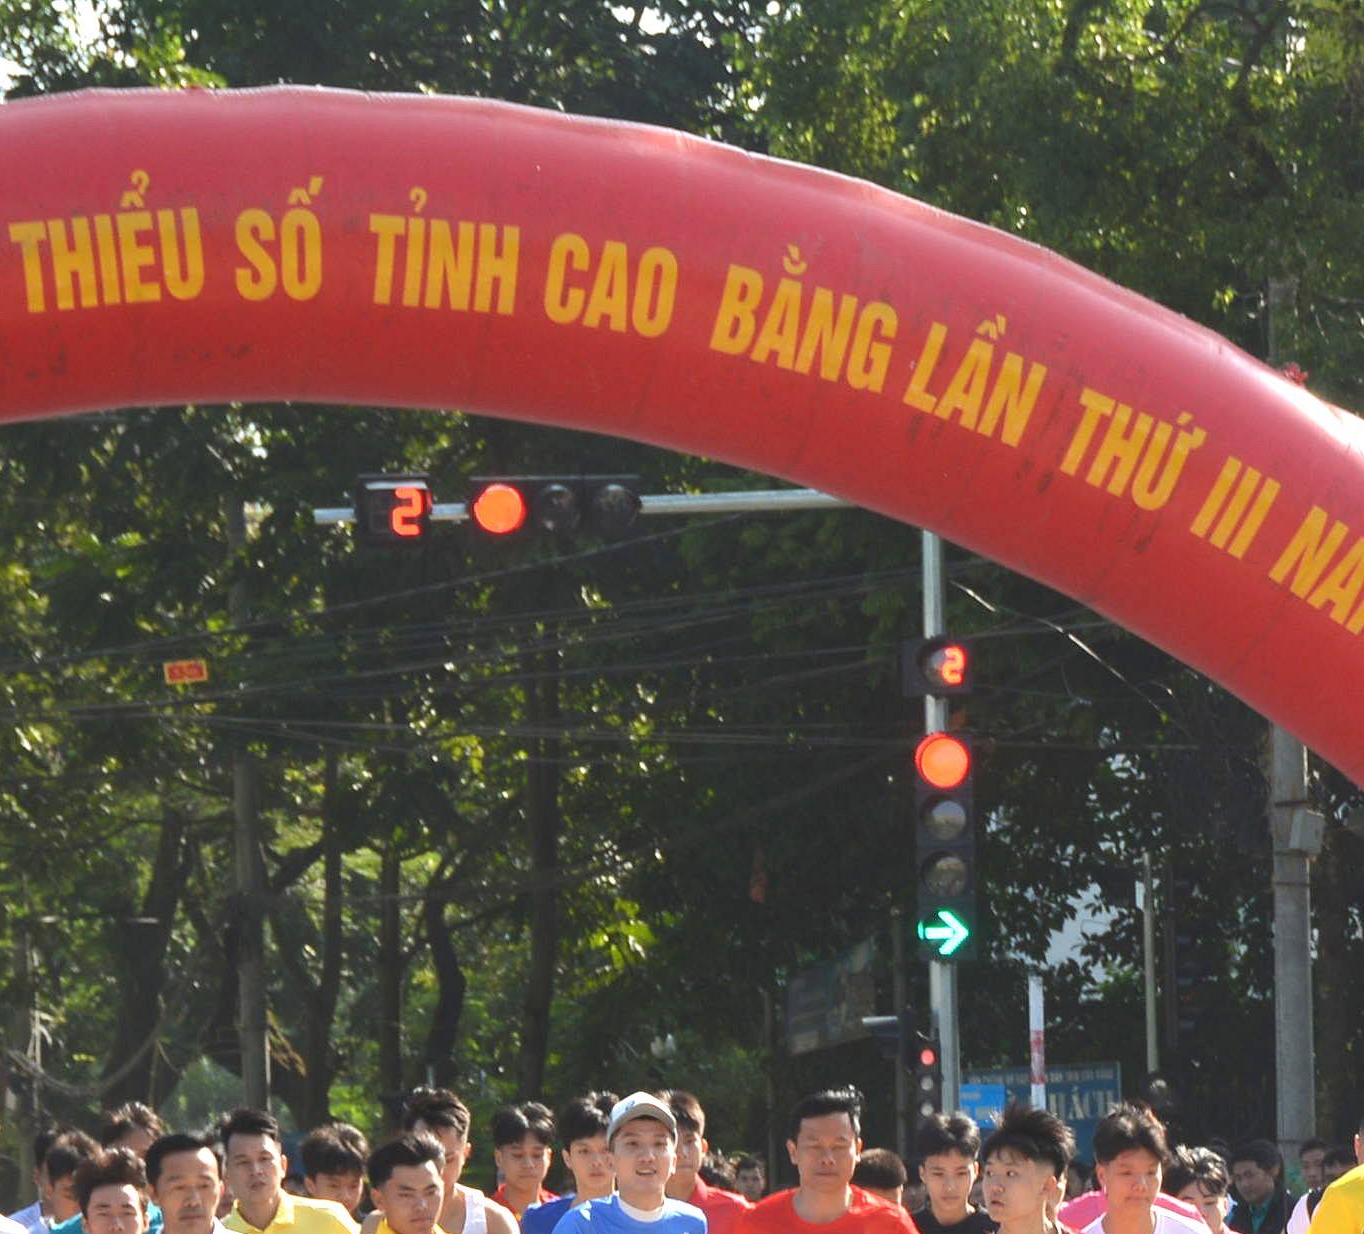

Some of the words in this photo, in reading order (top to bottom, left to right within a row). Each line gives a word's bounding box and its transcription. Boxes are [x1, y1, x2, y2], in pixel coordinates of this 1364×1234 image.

[8, 170, 205, 313] THIỂU
[235, 176, 323, 300] SỐ
[369, 187, 520, 315] TỈNH
[545, 234, 678, 337] CAO
[709, 244, 898, 392] BẰNG
[902, 313, 1047, 447] LẦN
[1059, 387, 1207, 511] THỨ
[1190, 457, 1281, 559] III
[392, 488, 422, 536] 2
[941, 646, 966, 685] 2
